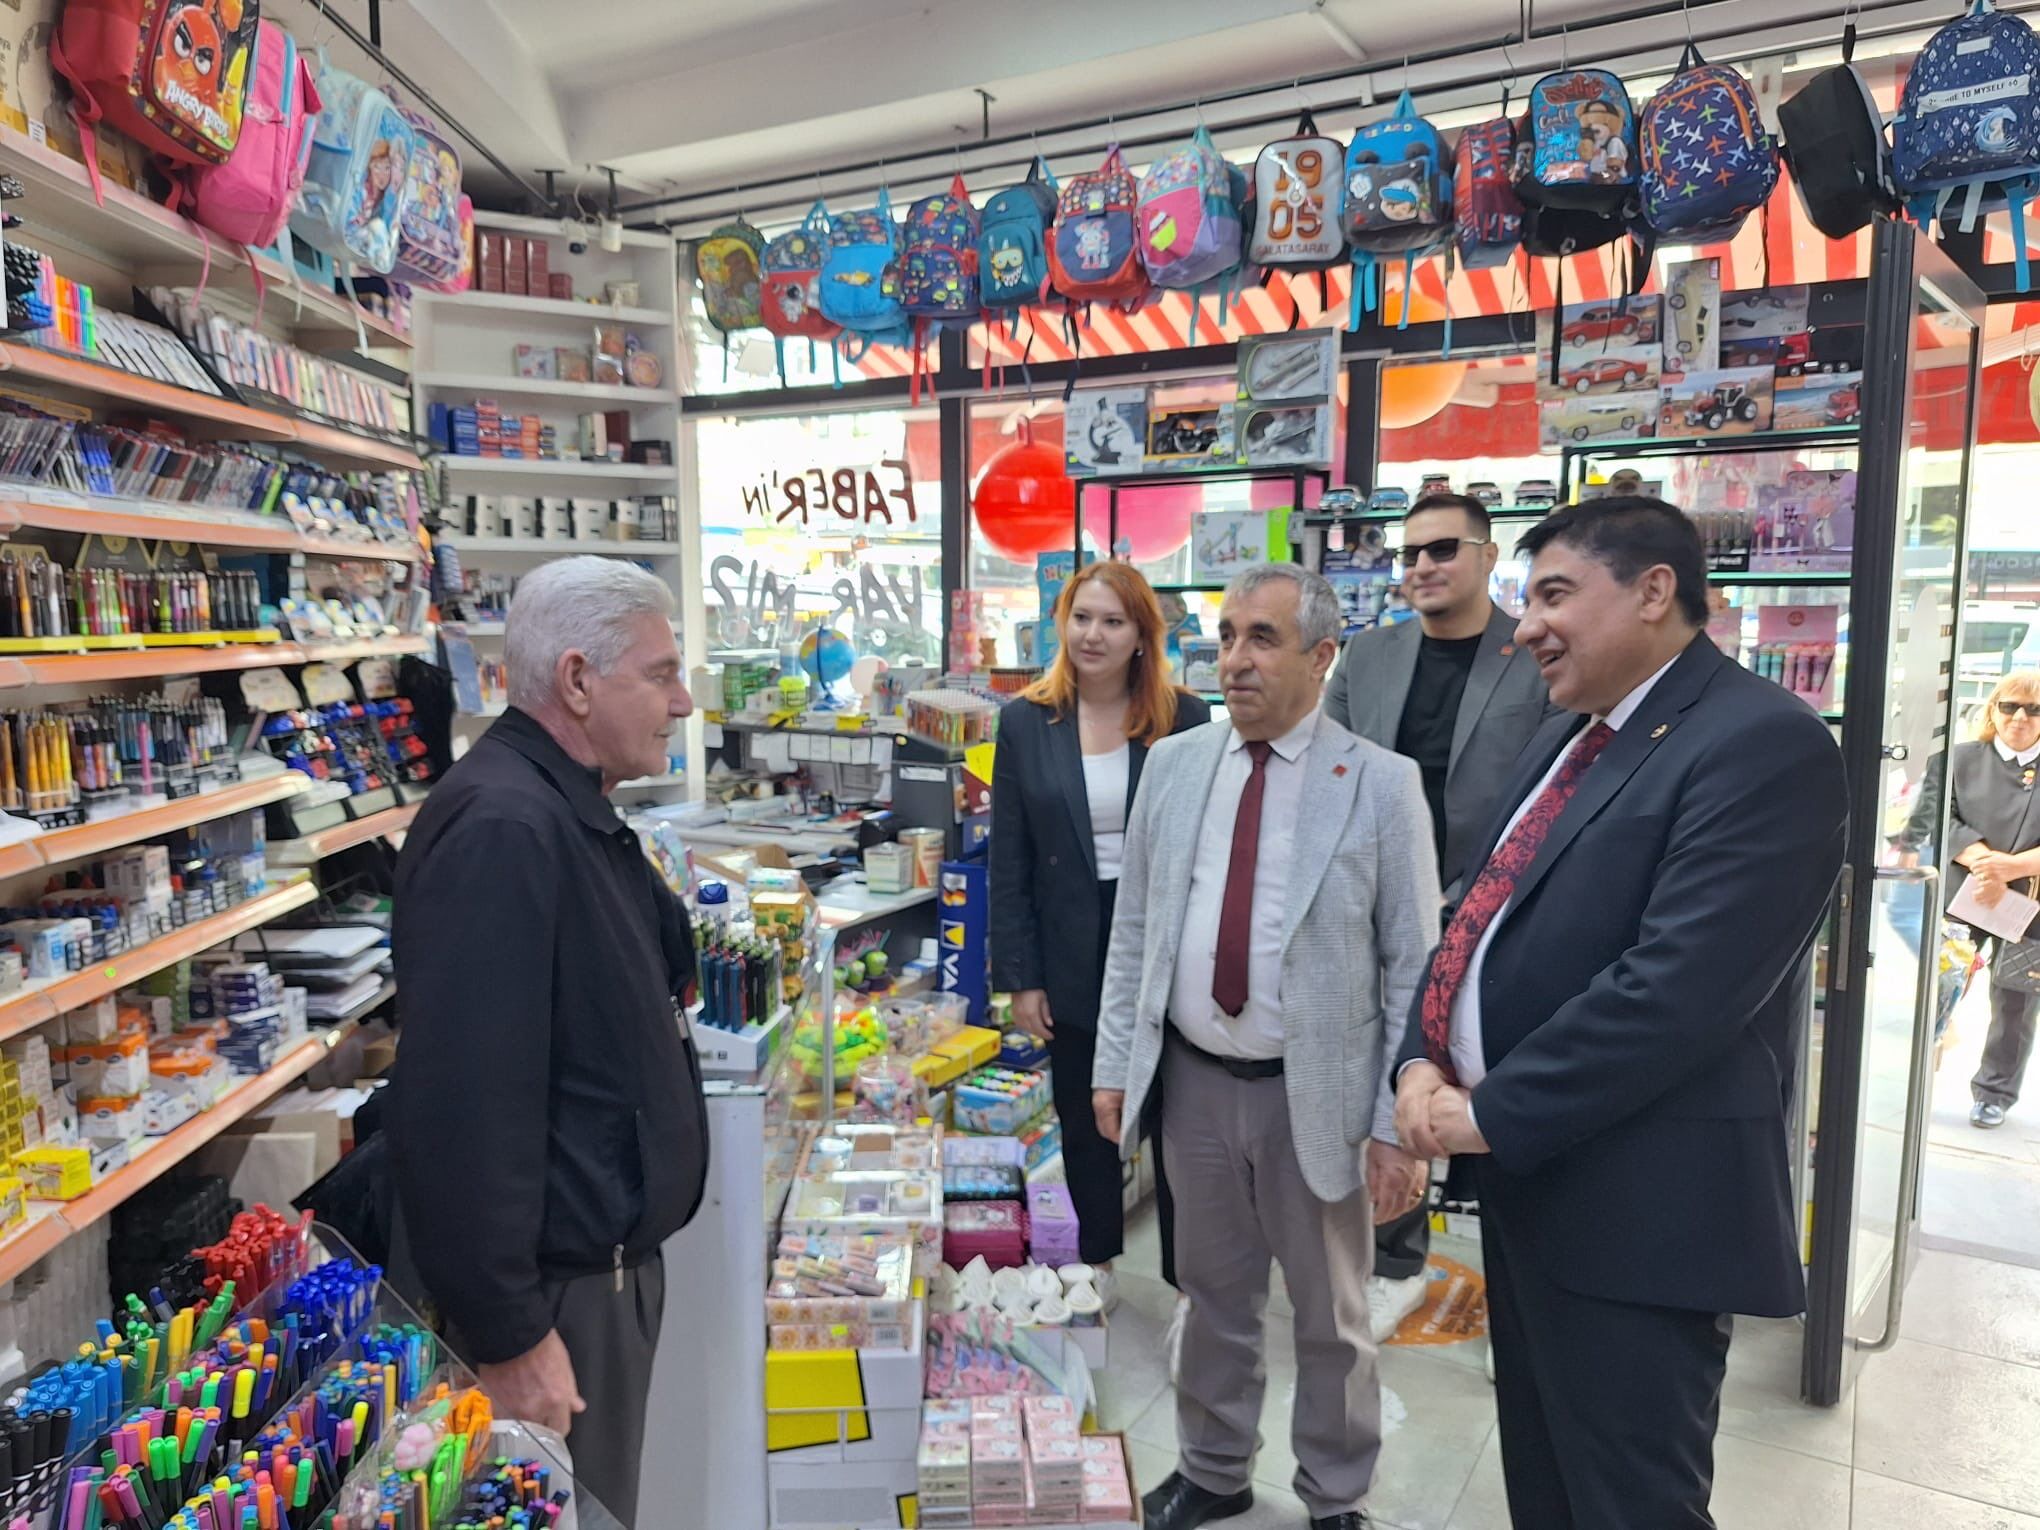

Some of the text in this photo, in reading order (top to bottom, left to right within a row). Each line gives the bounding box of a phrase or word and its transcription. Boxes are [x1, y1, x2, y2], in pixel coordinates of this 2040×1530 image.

[165, 80, 229, 138] ANGRY BIRDS
[1974, 84, 2004, 95] MYSELF
[1275, 150, 1322, 191] 19
[1268, 195, 1324, 240] 05
[1256, 243, 1330, 256] GALATASARAY
